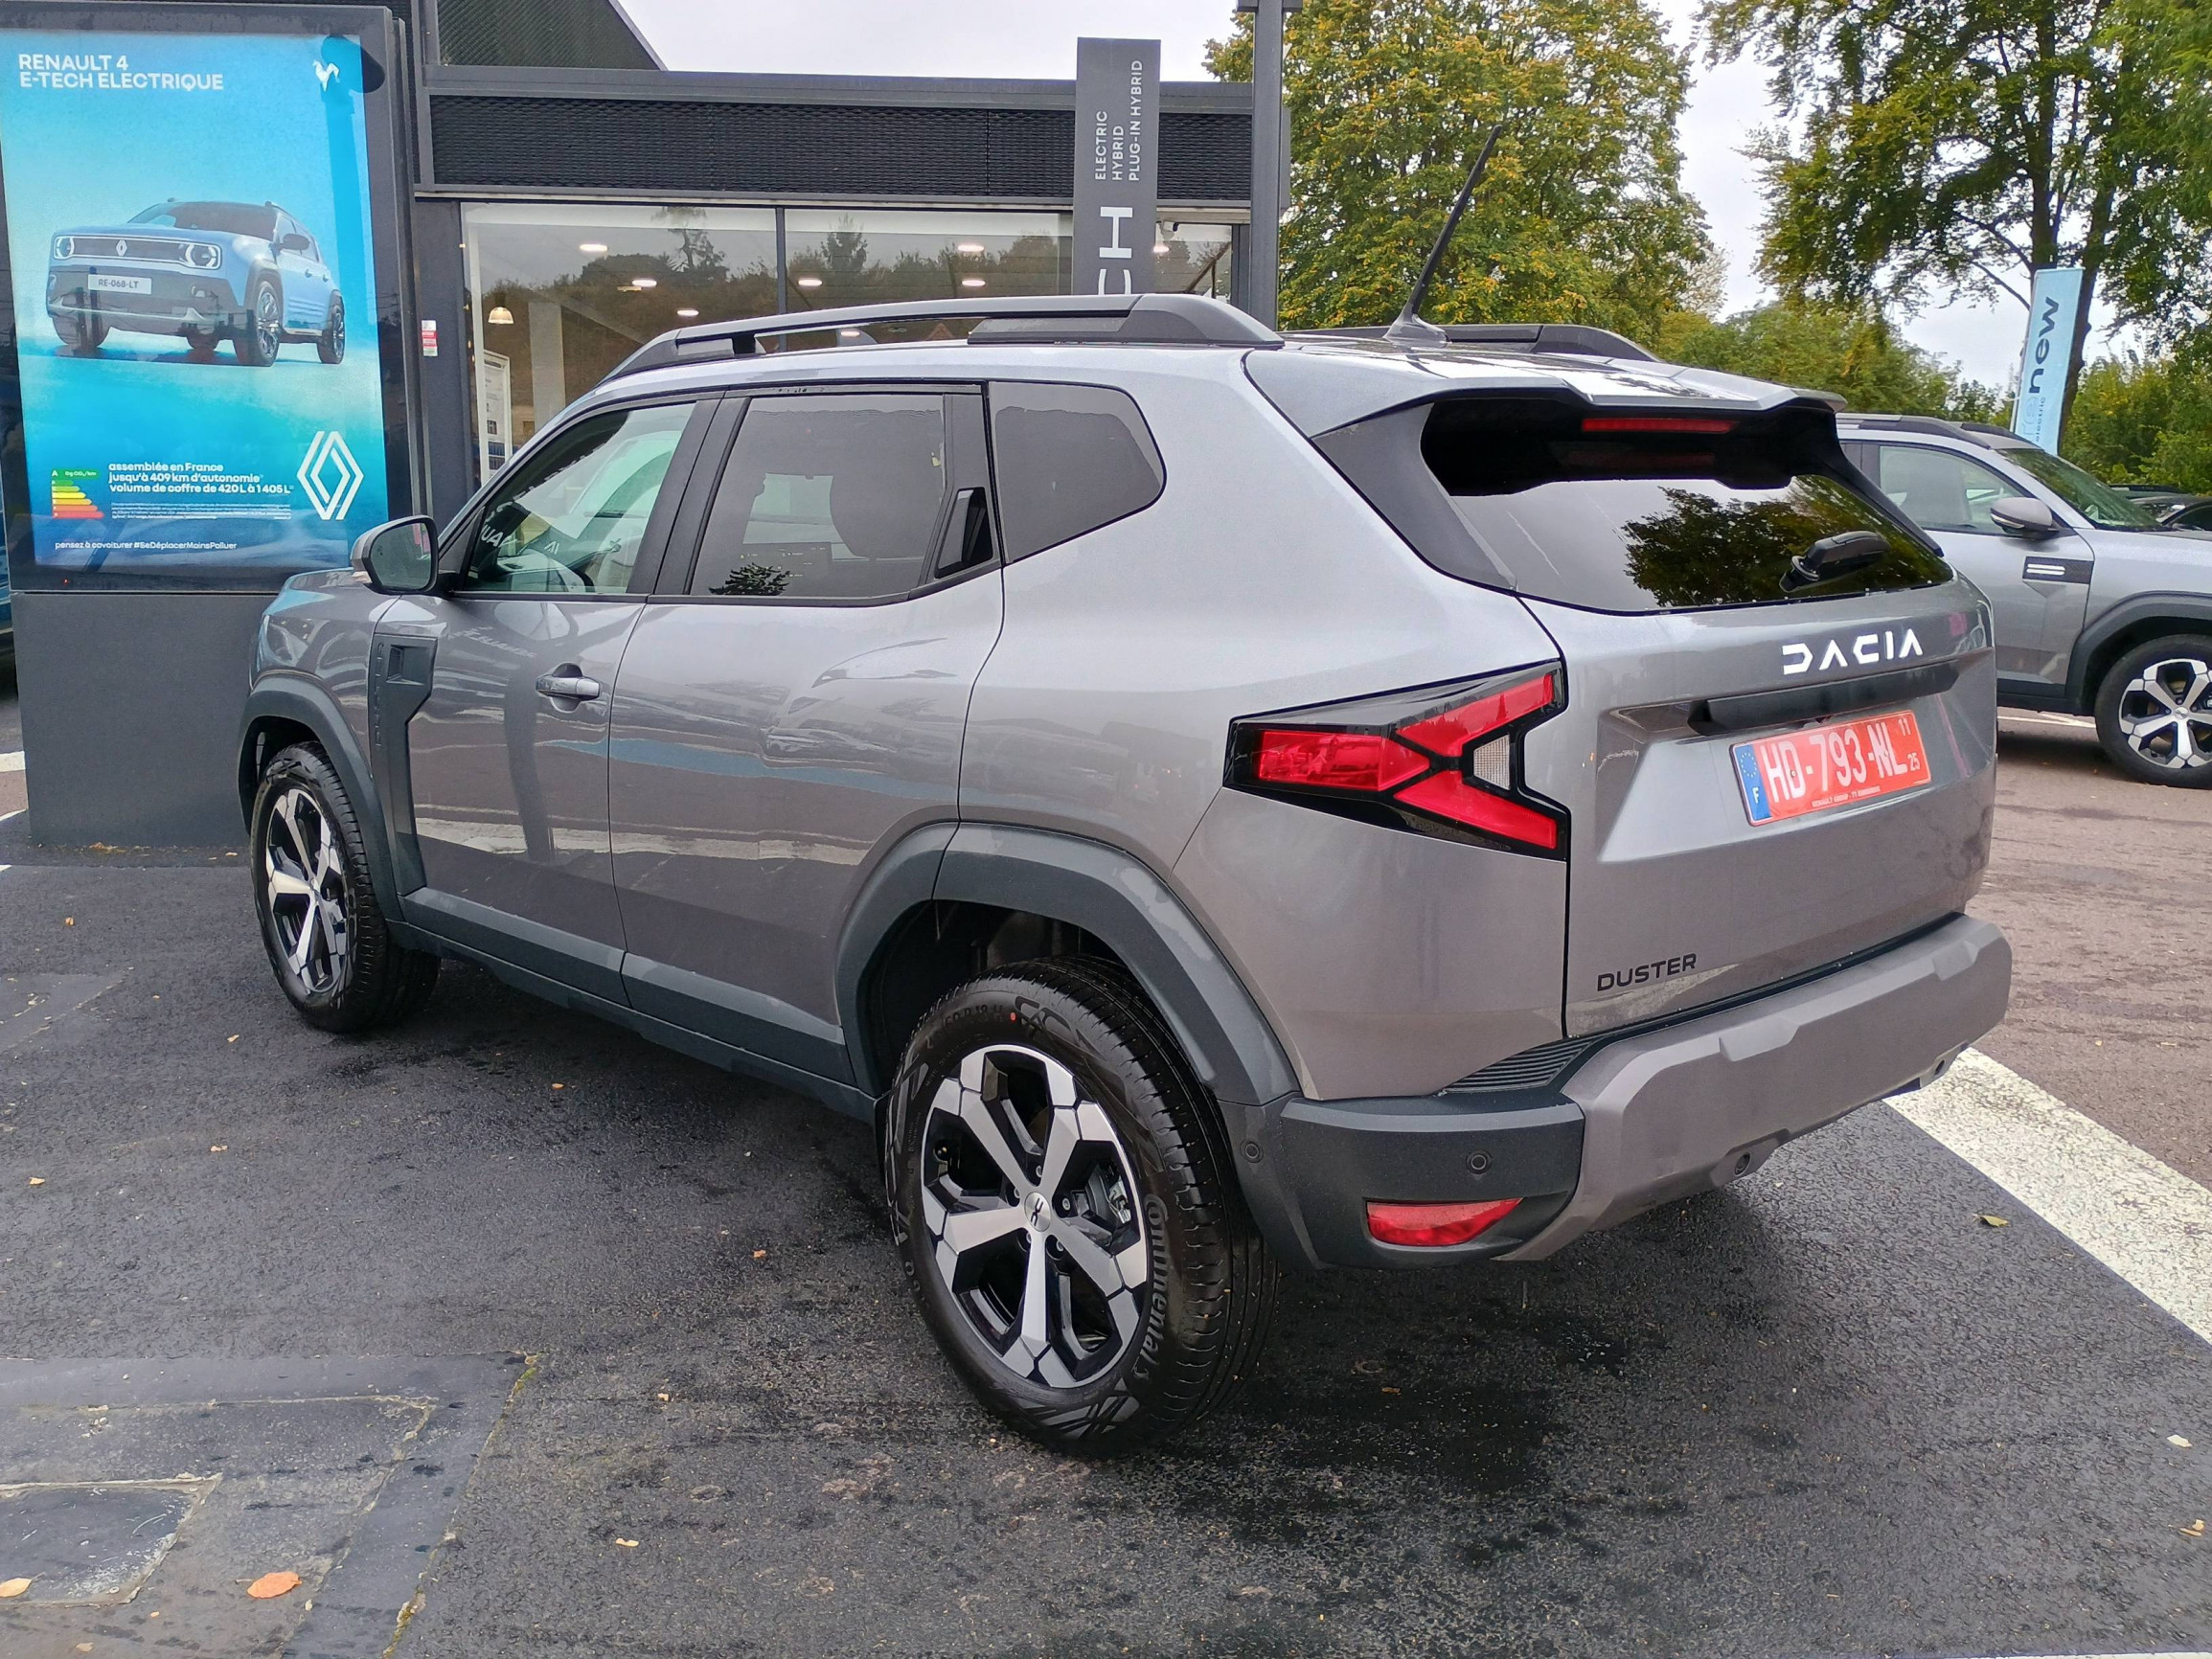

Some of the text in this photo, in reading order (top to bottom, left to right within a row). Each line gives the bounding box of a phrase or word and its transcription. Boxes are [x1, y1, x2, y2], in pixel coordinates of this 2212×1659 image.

[18, 54, 129, 71] RENAULT 4
[19, 73, 224, 91] E-TECH ELECTRIQUE
[1129, 59, 1143, 181] PLUG-IN HYBRID
[1095, 110, 1107, 180] ELECTRIC
[1111, 125, 1125, 181] HYBRID
[98, 278, 139, 289] RE-068-LT
[108, 462, 224, 472] assemblée en France
[108, 472, 261, 483] jusqu'à 409 km d'autonomie
[109, 484, 151, 492] volume
[152, 483, 167, 492] de
[168, 483, 201, 492] coffre
[202, 484, 217, 493] de
[217, 484, 238, 493] 420
[239, 484, 247, 493] L
[247, 484, 256, 493] à
[55, 542, 84, 551] pensez
[1782, 628, 1924, 675] DACIA
[1898, 717, 1911, 737] 11
[1760, 722, 1908, 803] HD-793-NL
[1907, 753, 1921, 771] 25
[1752, 786, 1760, 805] F
[1597, 953, 1697, 992] DUSTER
[1141, 1193, 1170, 1365] Continental
